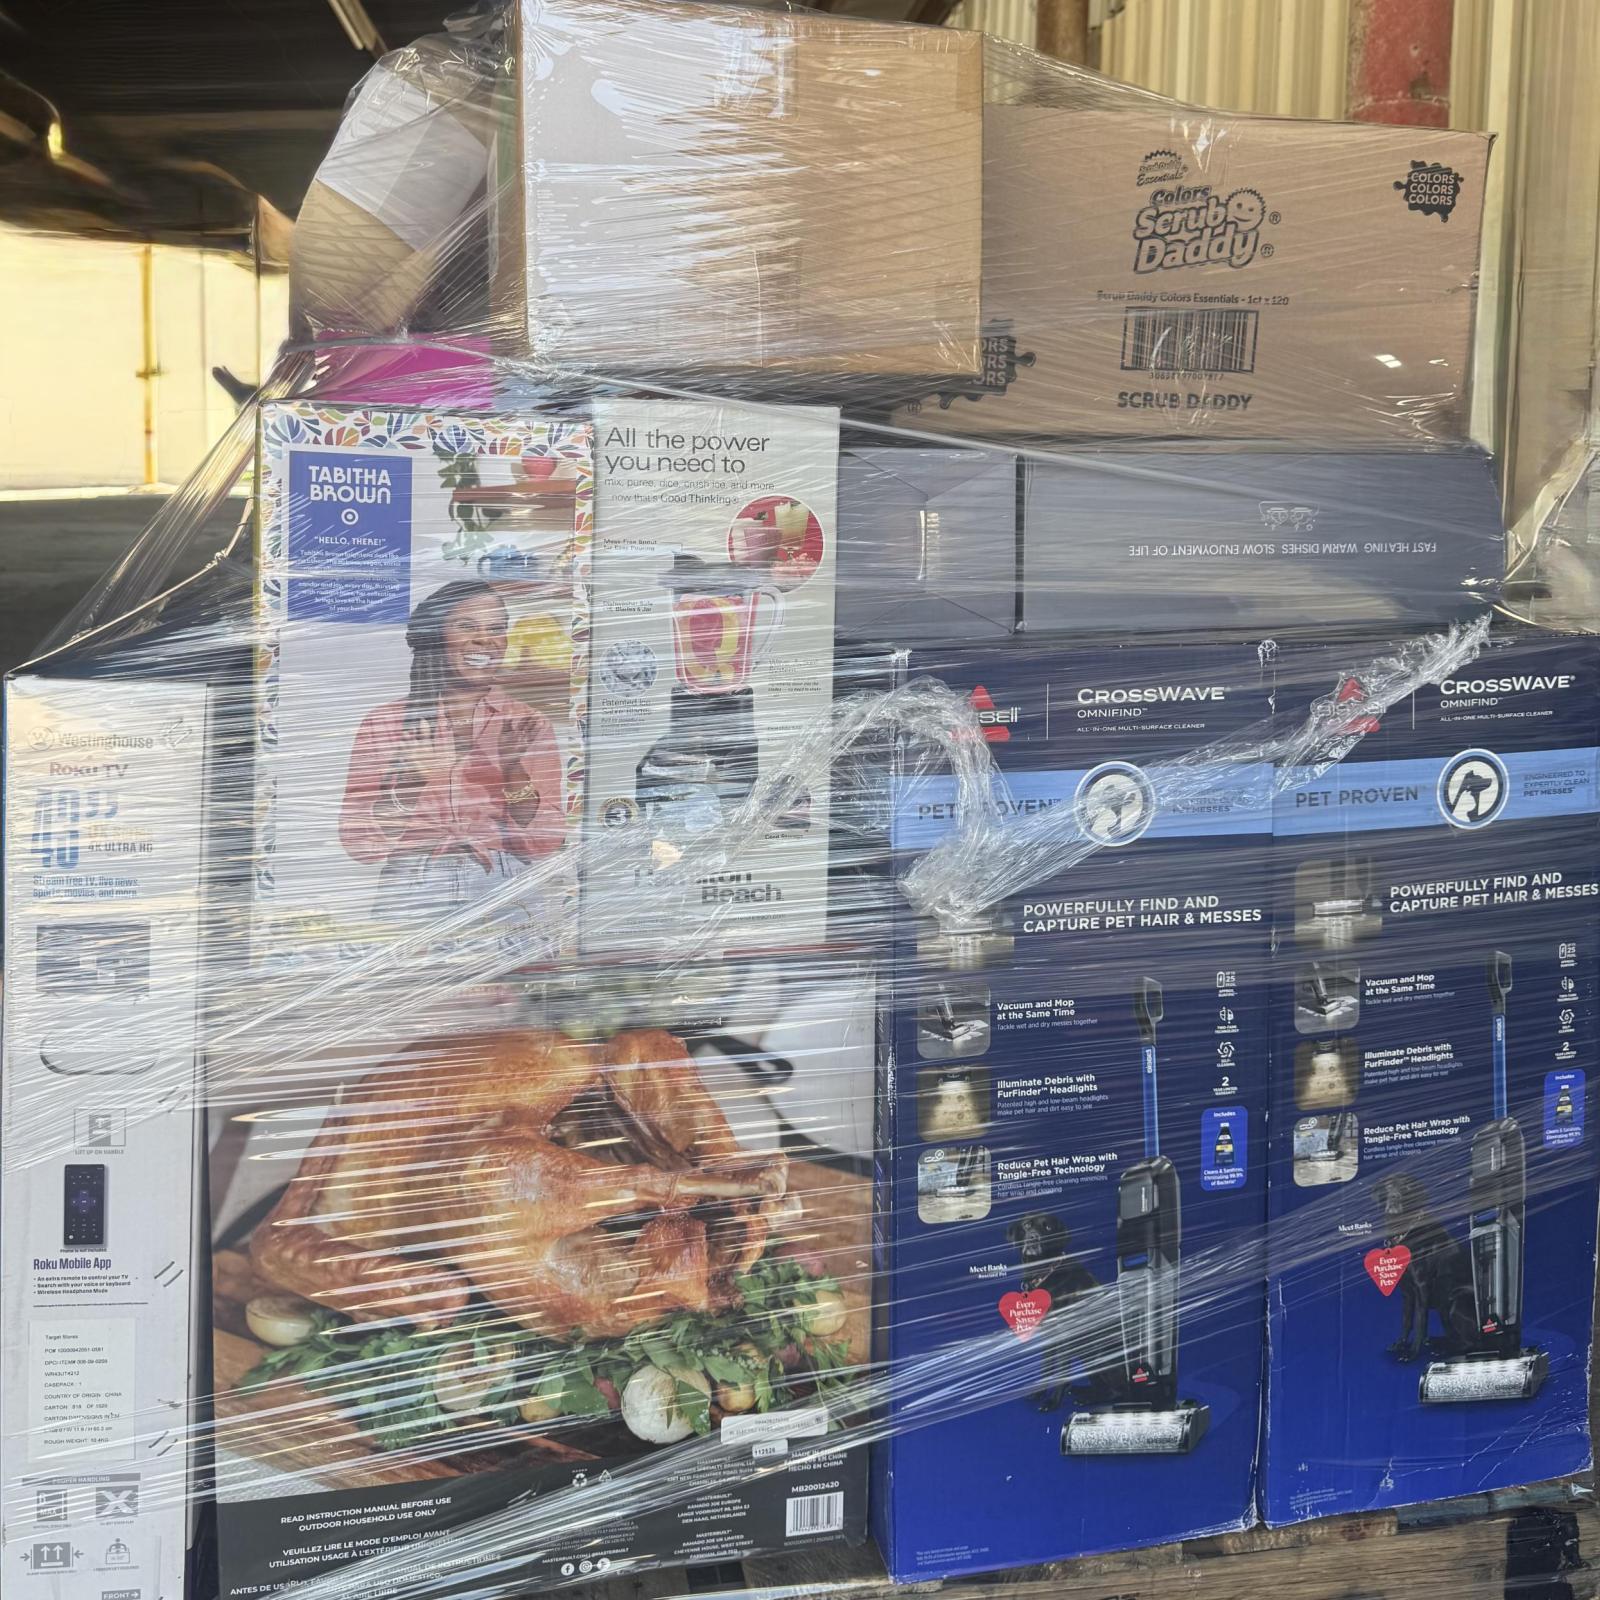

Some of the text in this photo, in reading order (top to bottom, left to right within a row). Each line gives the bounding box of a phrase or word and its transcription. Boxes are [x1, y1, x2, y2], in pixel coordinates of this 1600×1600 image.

[1411, 172, 1455, 184] COLORS
[1151, 185, 1211, 206] Colors
[1410, 183, 1454, 195] COLORS
[1408, 194, 1453, 206] COLORS
[1134, 197, 1228, 240] Scrub
[1134, 221, 1259, 274] Daddy
[1127, 291, 1158, 303] Daddy
[1160, 293, 1191, 303] Colors
[1193, 293, 1239, 304] Essentials
[1271, 296, 1289, 306] 120
[1117, 391, 1181, 410] SCRUB
[605, 427, 770, 454] All the power
[604, 454, 746, 474] you need to
[308, 465, 392, 486] TABITHA
[604, 479, 623, 488] mix,
[659, 478, 680, 489] dice,
[683, 479, 710, 489] crush
[730, 479, 748, 490] and
[310, 484, 391, 504] BROWN
[612, 494, 632, 502] now
[660, 493, 687, 503] Good
[314, 536, 387, 547] "HELLO, THERE!"
[1129, 542, 1437, 557] FAST HEATING WARM DISHES SLOW ENJOYMENT OF LIFE
[1078, 687, 1226, 704] CROSSWAVE
[58, 733, 154, 750] Westinghouse
[101, 763, 129, 777] TV
[1296, 790, 1332, 808] PET
[918, 804, 957, 821] PET
[1390, 872, 1562, 898] POWERFULLY FIND AND
[702, 884, 784, 903] Beach
[1390, 883, 1599, 914] CAPTURE PET HAIR & MESSES
[1023, 895, 1219, 917] POWERFULLY FIND AND
[1023, 909, 1263, 933] CAPTURE PET HAIR & MESSES
[997, 998, 1075, 1011] Vacuum and Mop
[997, 1008, 1075, 1021] at the Same Time
[1052, 1020, 1073, 1028] messes
[1365, 1043, 1452, 1060] Illuminate Debris with
[1562, 1042, 1570, 1051] 2
[1411, 1052, 1454, 1064] Headlights
[997, 1073, 1096, 1089] Illuminate Debris with
[1222, 1077, 1230, 1086] 2
[1050, 1083, 1099, 1095] Headlights
[1364, 1115, 1470, 1136] Reduce Pet Hair Wrap with
[1364, 1126, 1459, 1144] Tangle-Free Technology
[997, 1152, 1118, 1171] Reduce Pet Hair Wrap with
[997, 1163, 1105, 1181] Tangle-Free Technology
[1338, 1221, 1372, 1232] Meet Banks
[33, 1257, 112, 1271] Roku Mobile App
[969, 1263, 1007, 1274] Meet Banks
[1373, 1263, 1403, 1273] Purchase
[1379, 1257, 1397, 1266] Every
[1379, 1271, 1397, 1280] Saves
[1009, 1307, 1041, 1318] Purchase
[1016, 1301, 1036, 1310] Every
[792, 1480, 840, 1493] MB20012420
[280, 1497, 452, 1525] READ INSTRUCTION MANUAL BEFORE USE
[298, 1508, 437, 1532] OUTDOOR HOUSEHOLD USE ONLY
[283, 1544, 322, 1557] VEUILLEZ
[323, 1542, 342, 1552] LIRE
[343, 1541, 353, 1549] LE
[355, 1537, 382, 1548] MODE
[382, 1532, 422, 1545] D'EMPLOI
[423, 1529, 450, 1540] AVANT
[269, 1555, 320, 1568] UTILISATION
[321, 1550, 350, 1563] USAGE
[103, 1592, 130, 1600] FRONT
[230, 1583, 272, 1596] ANTES DE
